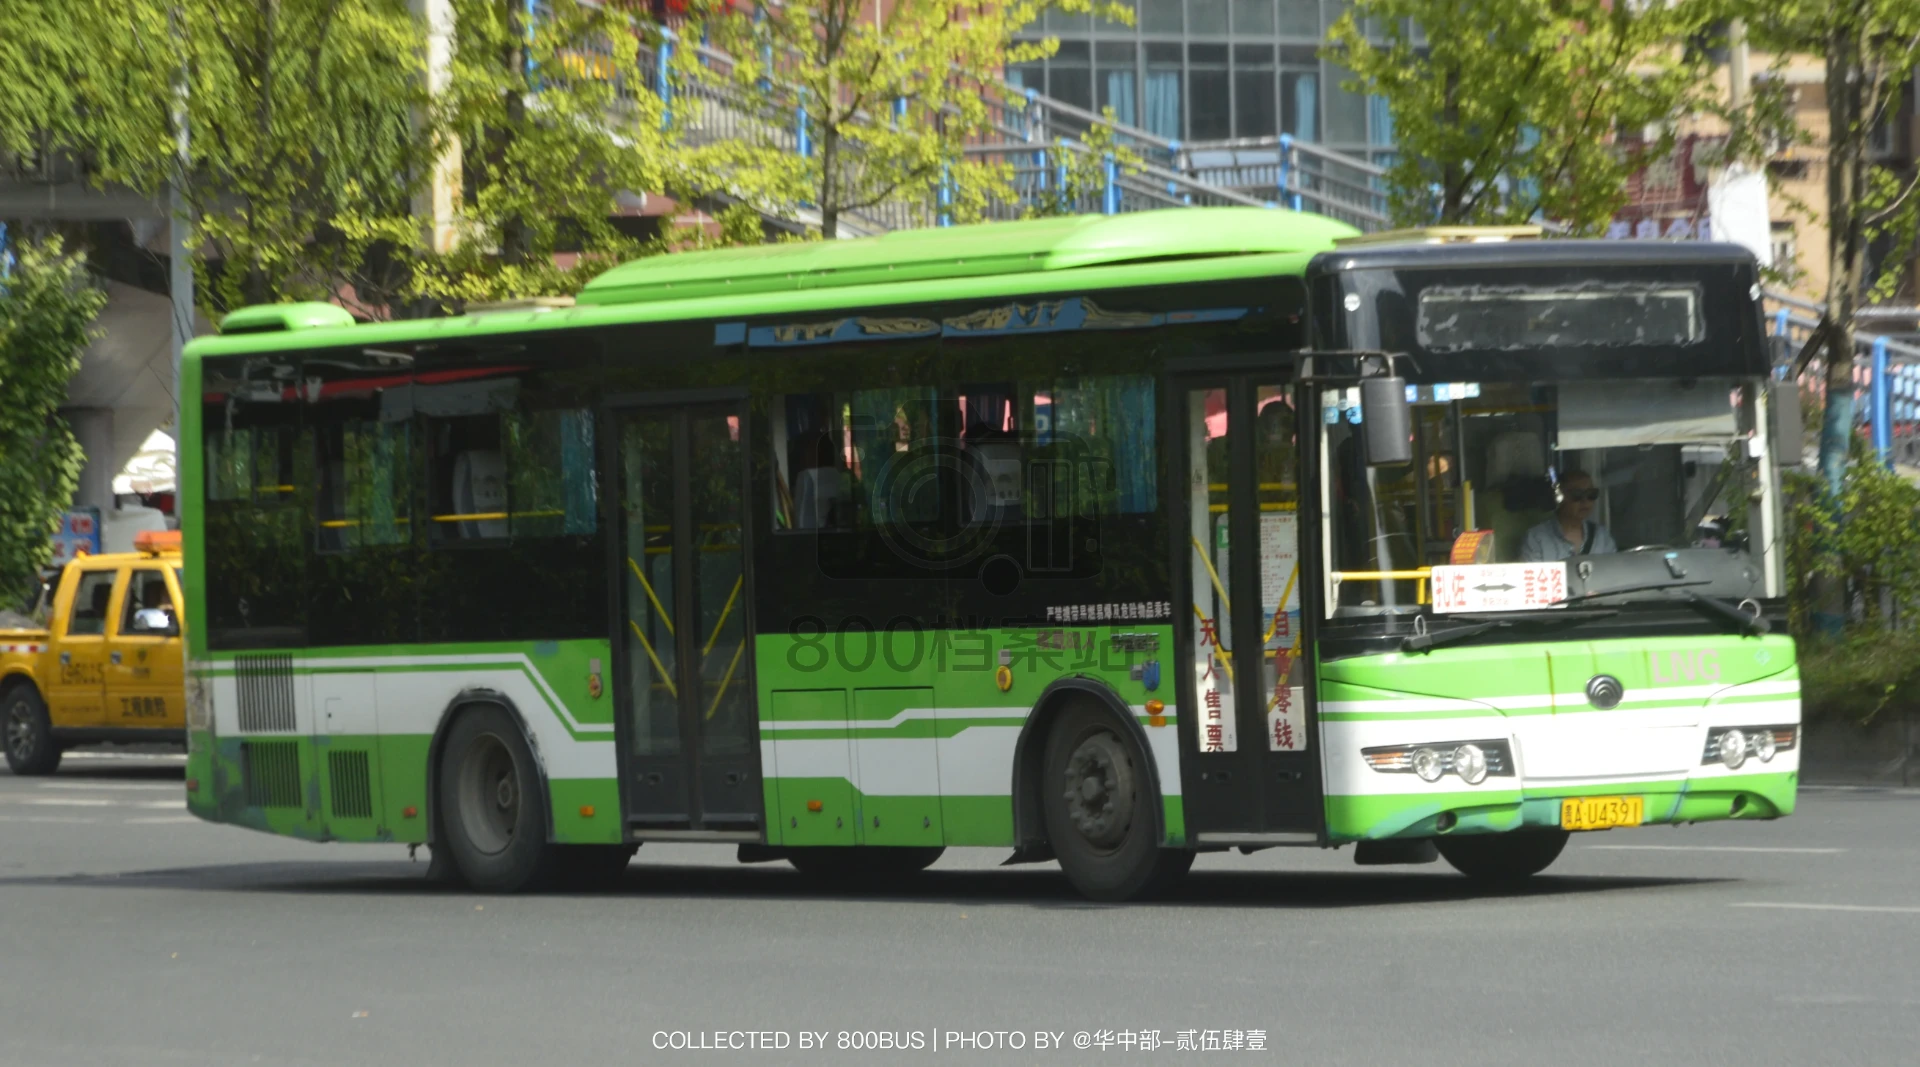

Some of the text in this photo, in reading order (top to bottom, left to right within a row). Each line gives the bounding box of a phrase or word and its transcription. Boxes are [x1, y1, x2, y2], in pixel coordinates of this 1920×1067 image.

[1200, 619, 1223, 752] 无人售票
[1273, 608, 1294, 750] 自备零钱
[1651, 648, 1721, 682] LNG
